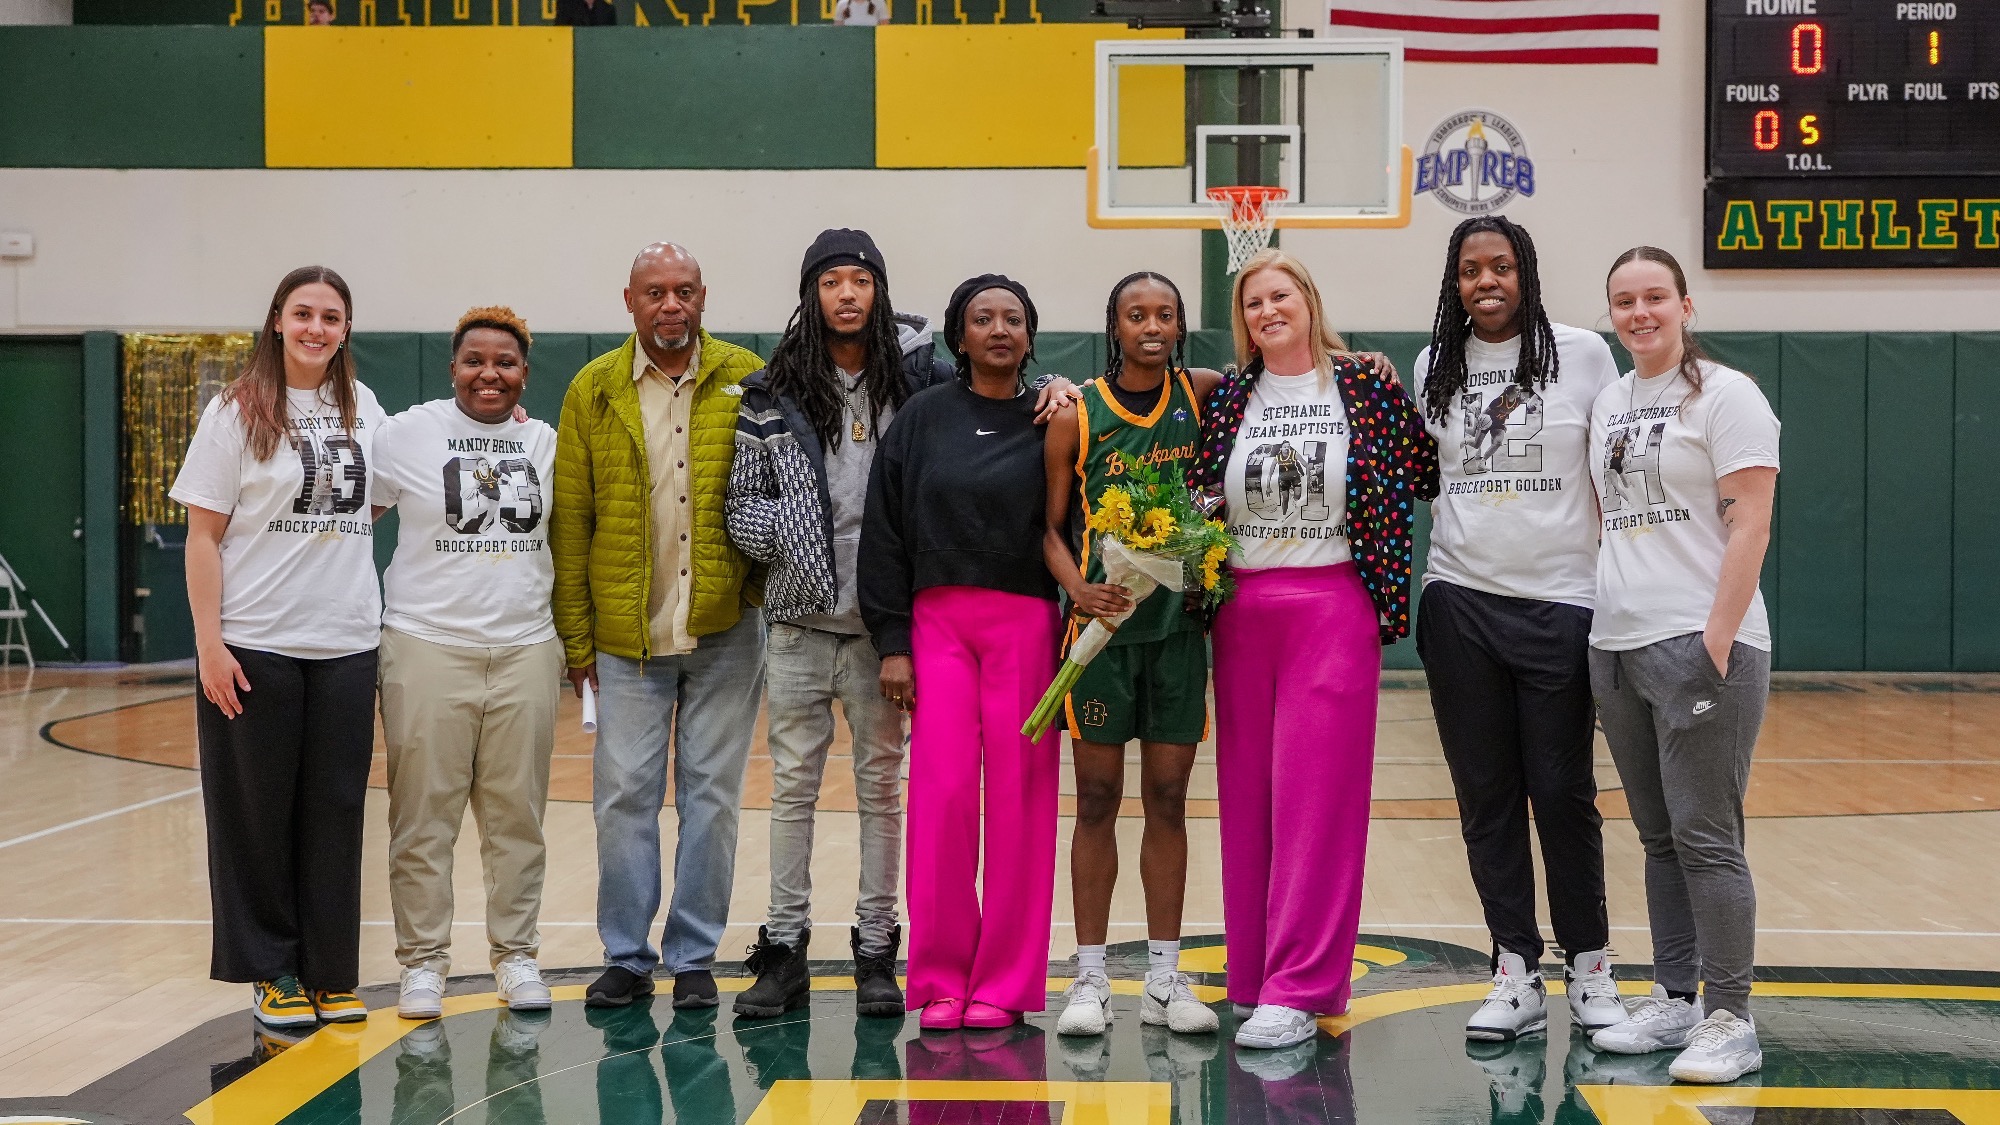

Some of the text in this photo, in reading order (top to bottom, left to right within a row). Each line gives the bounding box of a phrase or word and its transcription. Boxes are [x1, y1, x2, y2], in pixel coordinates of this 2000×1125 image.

[1746, 0, 1817, 15] HOME
[1896, 3, 1957, 20] PERIOD
[1792, 23, 1822, 74] 0
[1929, 31, 1939, 65] 1
[1726, 84, 1780, 102] FOULS
[1848, 82, 2000, 101] PLYR FOUL PTS
[1754, 110, 1819, 150] 0 5
[1786, 153, 1832, 170] T.O.L.
[1717, 200, 2000, 250] ATHLET
[1465, 370, 1507, 387] DISON
[1262, 405, 1331, 421] STEPHANIE
[1245, 422, 1344, 439] JEAN-BAPTISTE
[448, 438, 525, 453] MANDY BRINK
[1448, 478, 1562, 494] BROCKPORT GOLDEN
[436, 540, 507, 552] BROCKPORT
